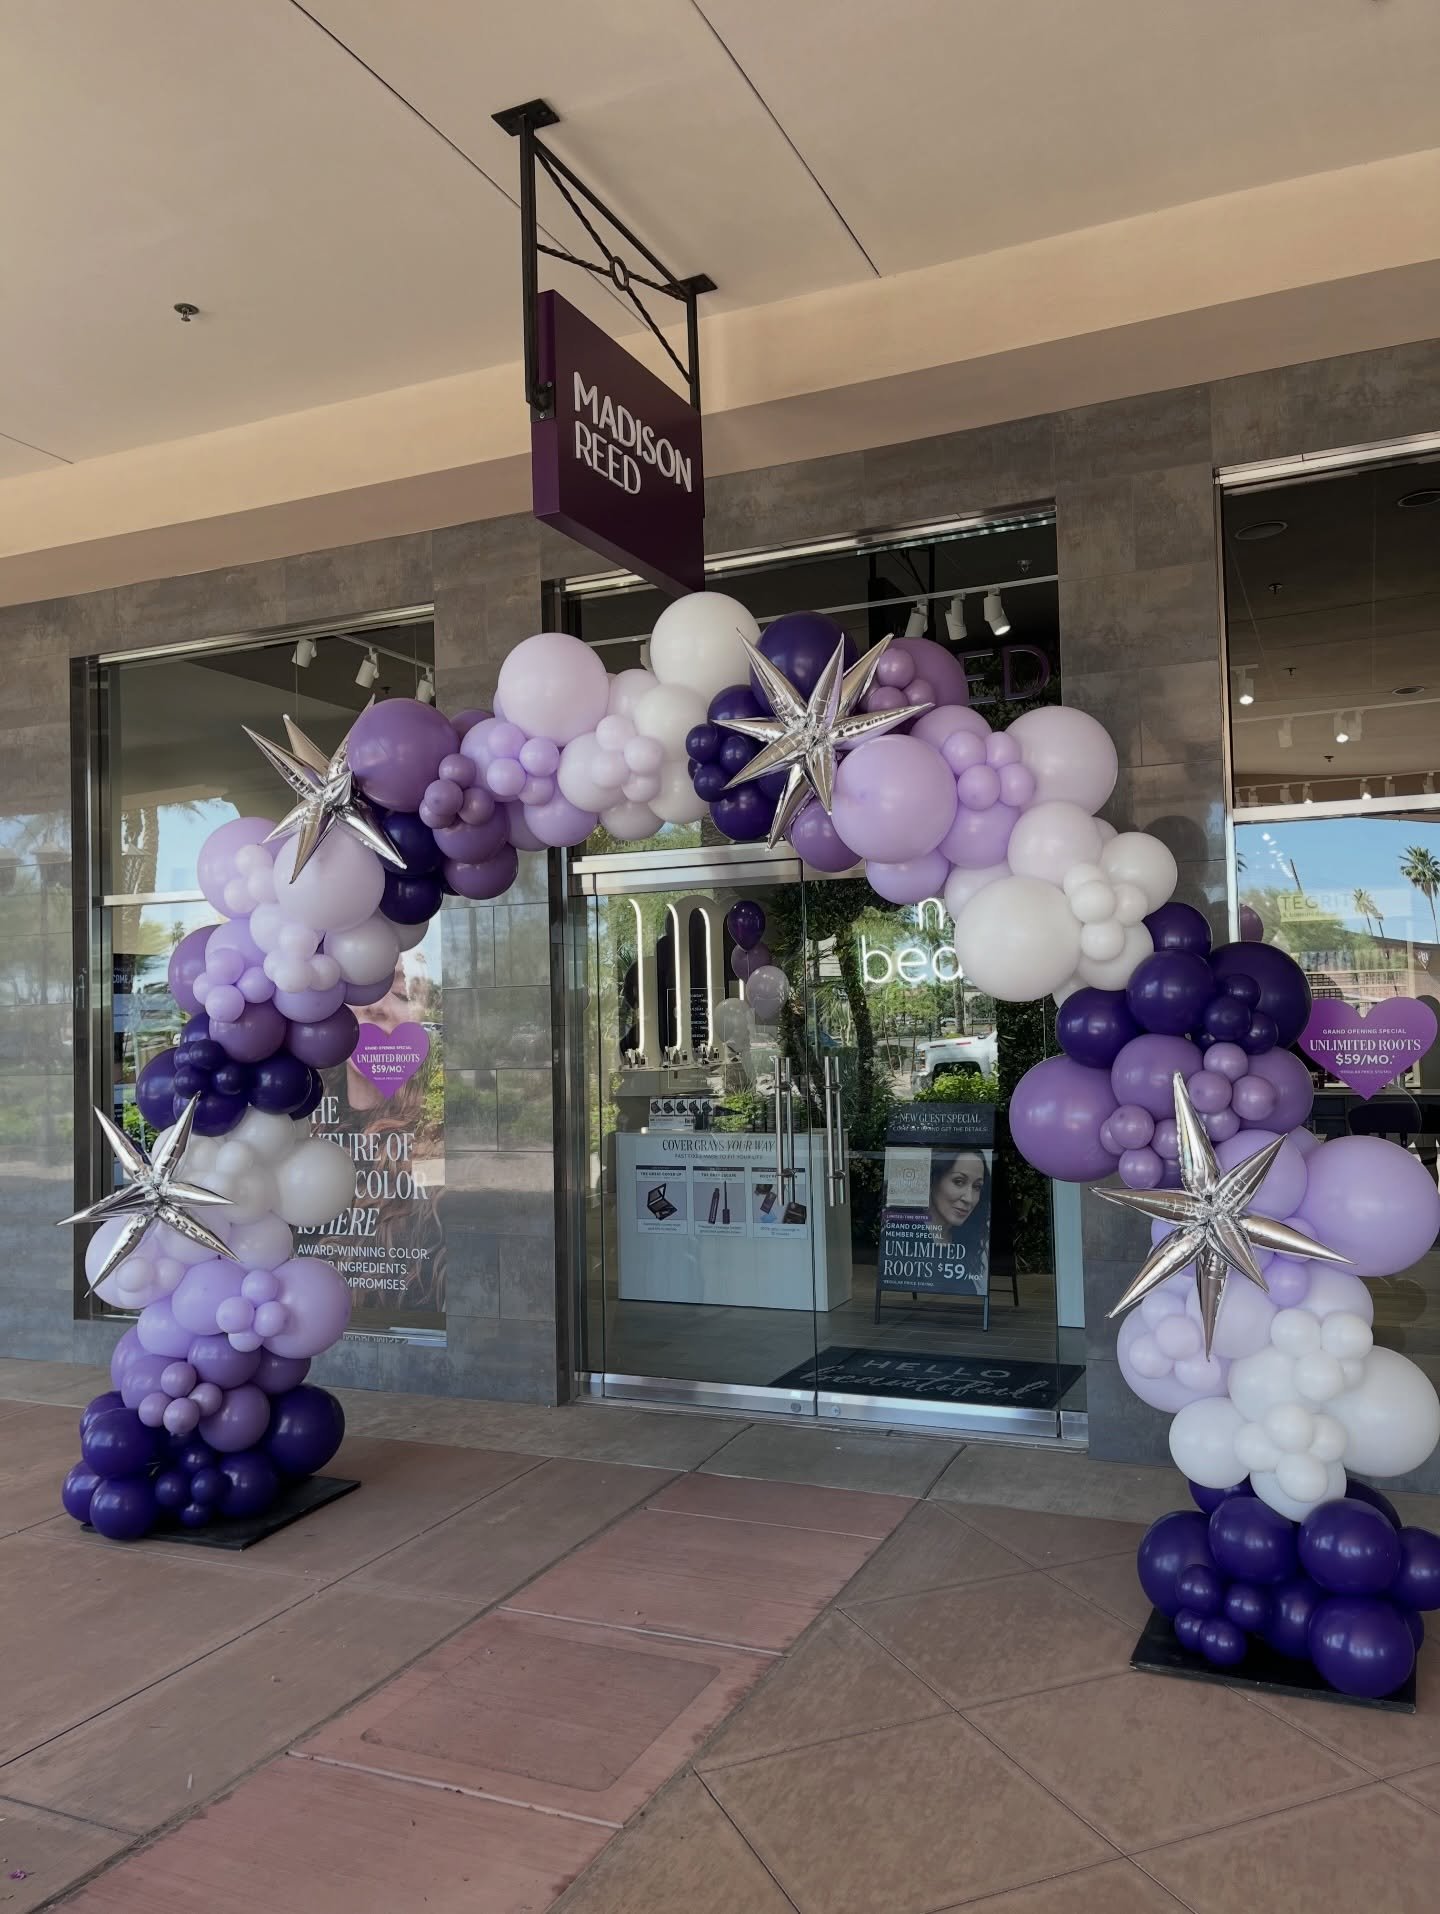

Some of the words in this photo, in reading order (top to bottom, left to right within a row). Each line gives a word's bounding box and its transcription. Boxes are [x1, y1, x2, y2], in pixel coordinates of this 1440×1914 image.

[573, 370, 693, 493] MADISON
[575, 420, 642, 494] REED
[1309, 1039, 1376, 1052] UNLIMITED
[1379, 1038, 1421, 1051] ROOTS
[356, 1053, 395, 1064] UNLIMITED
[396, 1053, 420, 1063] ROOTS
[311, 1095, 340, 1125] HE
[900, 1113, 918, 1123] NEW
[919, 1113, 946, 1123] GUEST
[947, 1113, 981, 1124] SPECIAL
[387, 1132, 415, 1162] OF
[662, 1139, 693, 1151] COVER
[694, 1139, 725, 1152] GRAYS
[726, 1139, 753, 1153] YOUR
[753, 1140, 776, 1153] WAY
[355, 1170, 430, 1200] COLOR
[886, 1222, 910, 1230] GRAND
[911, 1223, 943, 1232] OPENING
[915, 1232, 944, 1240] SPECIAL
[297, 1243, 386, 1259] AWARD-WINNING
[388, 1247, 431, 1260] COLOR.
[885, 1240, 966, 1260] UNLIMITED
[337, 1261, 409, 1276] INGREDIENTS.
[883, 1259, 933, 1278] ROOTS
[344, 1277, 409, 1291] MPROMISES.
[863, 1359, 1011, 1380] HELLO
